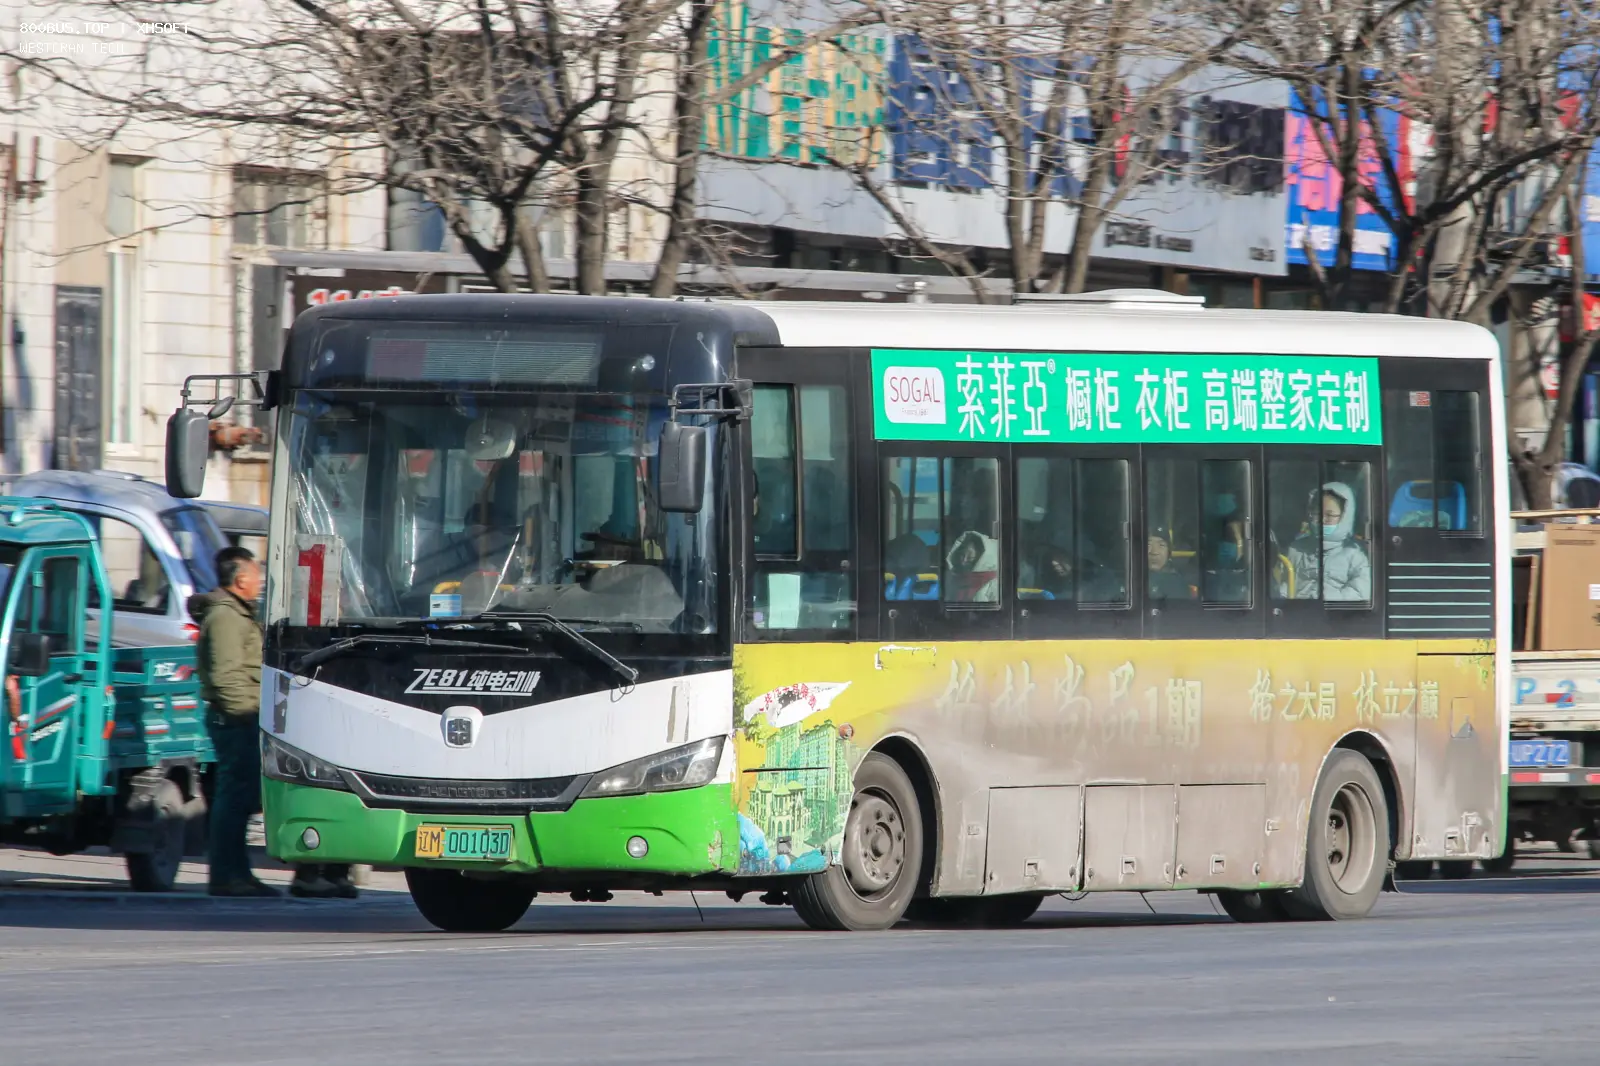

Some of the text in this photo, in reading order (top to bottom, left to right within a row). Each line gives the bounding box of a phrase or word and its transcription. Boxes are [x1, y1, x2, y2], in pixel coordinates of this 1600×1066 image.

[889, 376, 941, 403] SOGAL
[1065, 367, 1122, 431] 橱柜
[1134, 367, 1191, 431] 衣柜
[1202, 368, 1370, 433] 高端整家定制
[298, 544, 326, 627] 1
